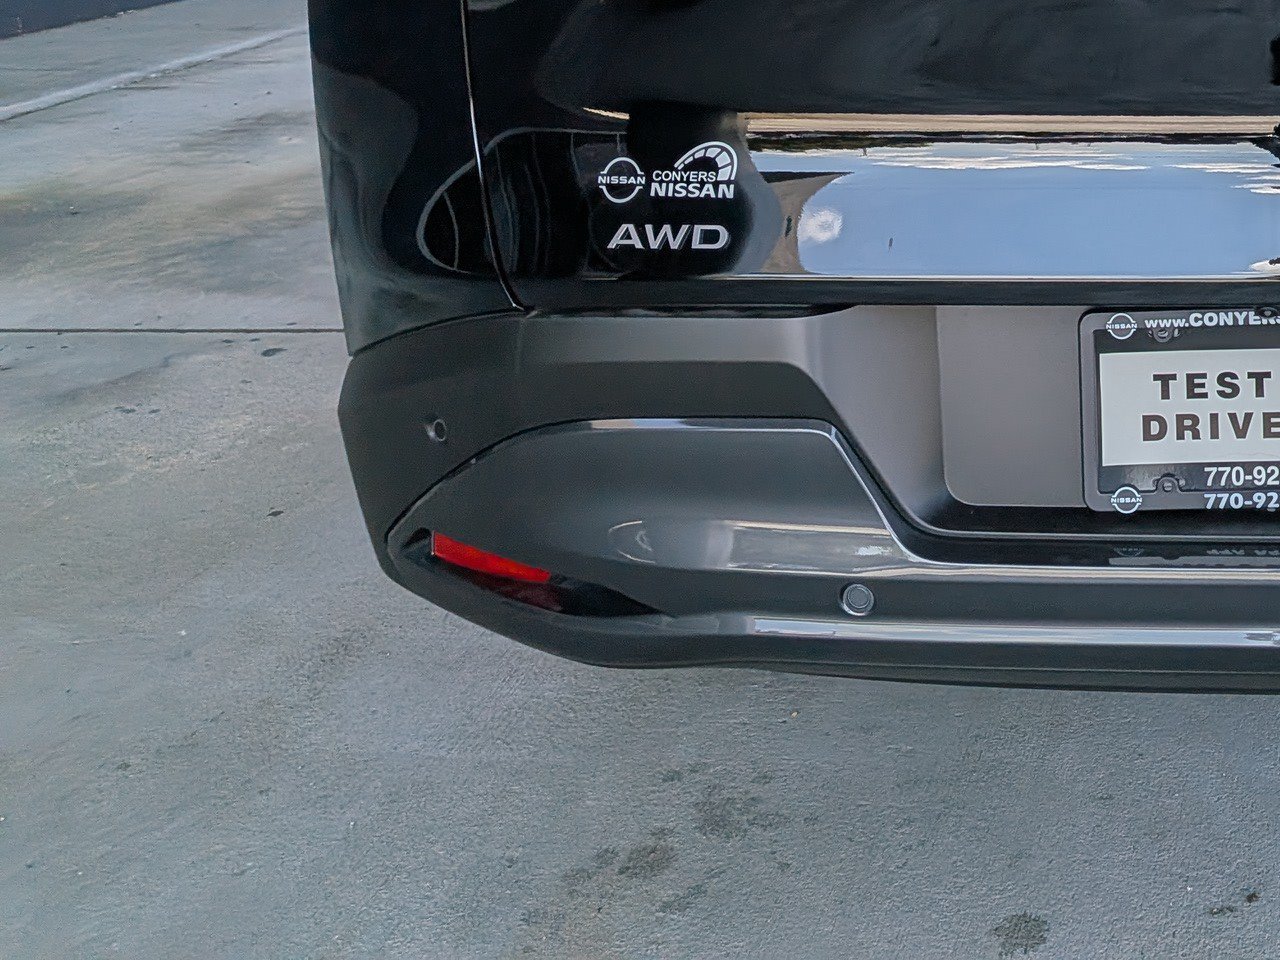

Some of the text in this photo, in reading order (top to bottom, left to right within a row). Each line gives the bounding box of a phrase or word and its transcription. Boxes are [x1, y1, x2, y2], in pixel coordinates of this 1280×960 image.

[598, 175, 645, 184] NISSAN
[652, 170, 716, 182] CONYERS
[650, 182, 735, 199] NISSAN
[607, 223, 731, 250] AWD
[1152, 371, 1273, 400] TEST
